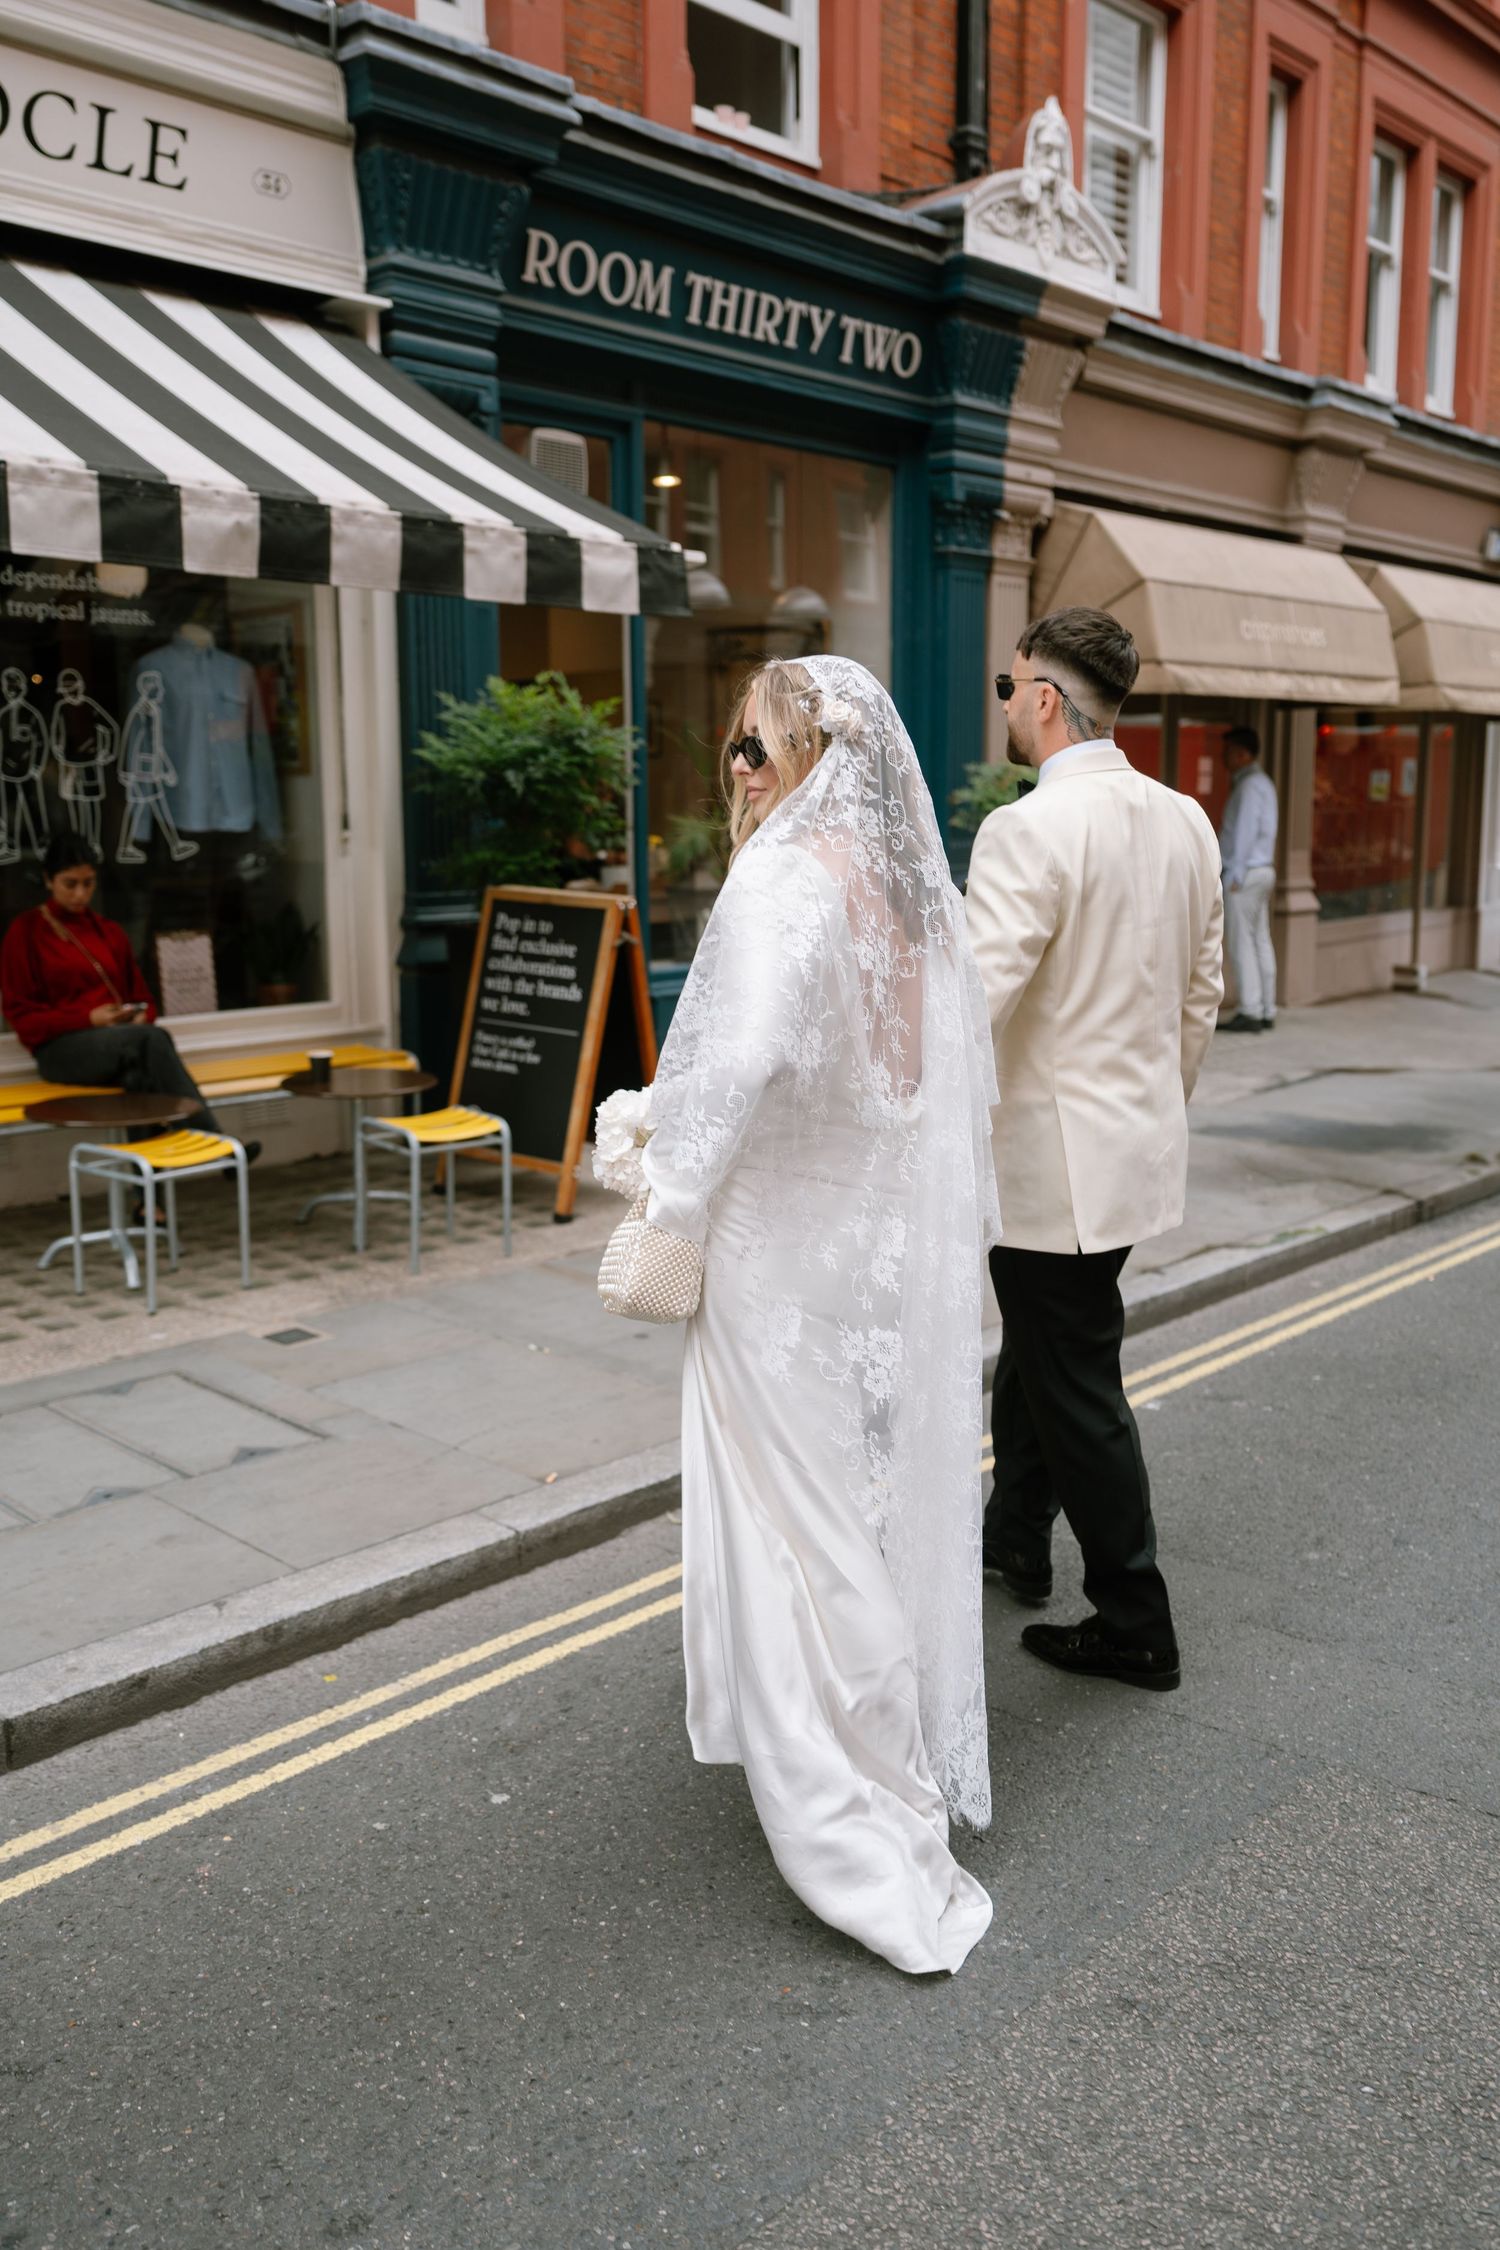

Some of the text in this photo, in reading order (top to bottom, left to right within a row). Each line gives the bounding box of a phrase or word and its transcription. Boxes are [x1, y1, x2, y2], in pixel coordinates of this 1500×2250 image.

[0, 81, 188, 191] CLE
[521, 227, 923, 379] ROOM THIRTY TWO
[6, 598, 155, 626] tropical jaunts.
[495, 911, 554, 935] Pop in to
[491, 932, 577, 959] find exclusive
[487, 954, 577, 980] collaborations
[484, 974, 583, 1002] with the brands
[480, 996, 499, 1012] we
